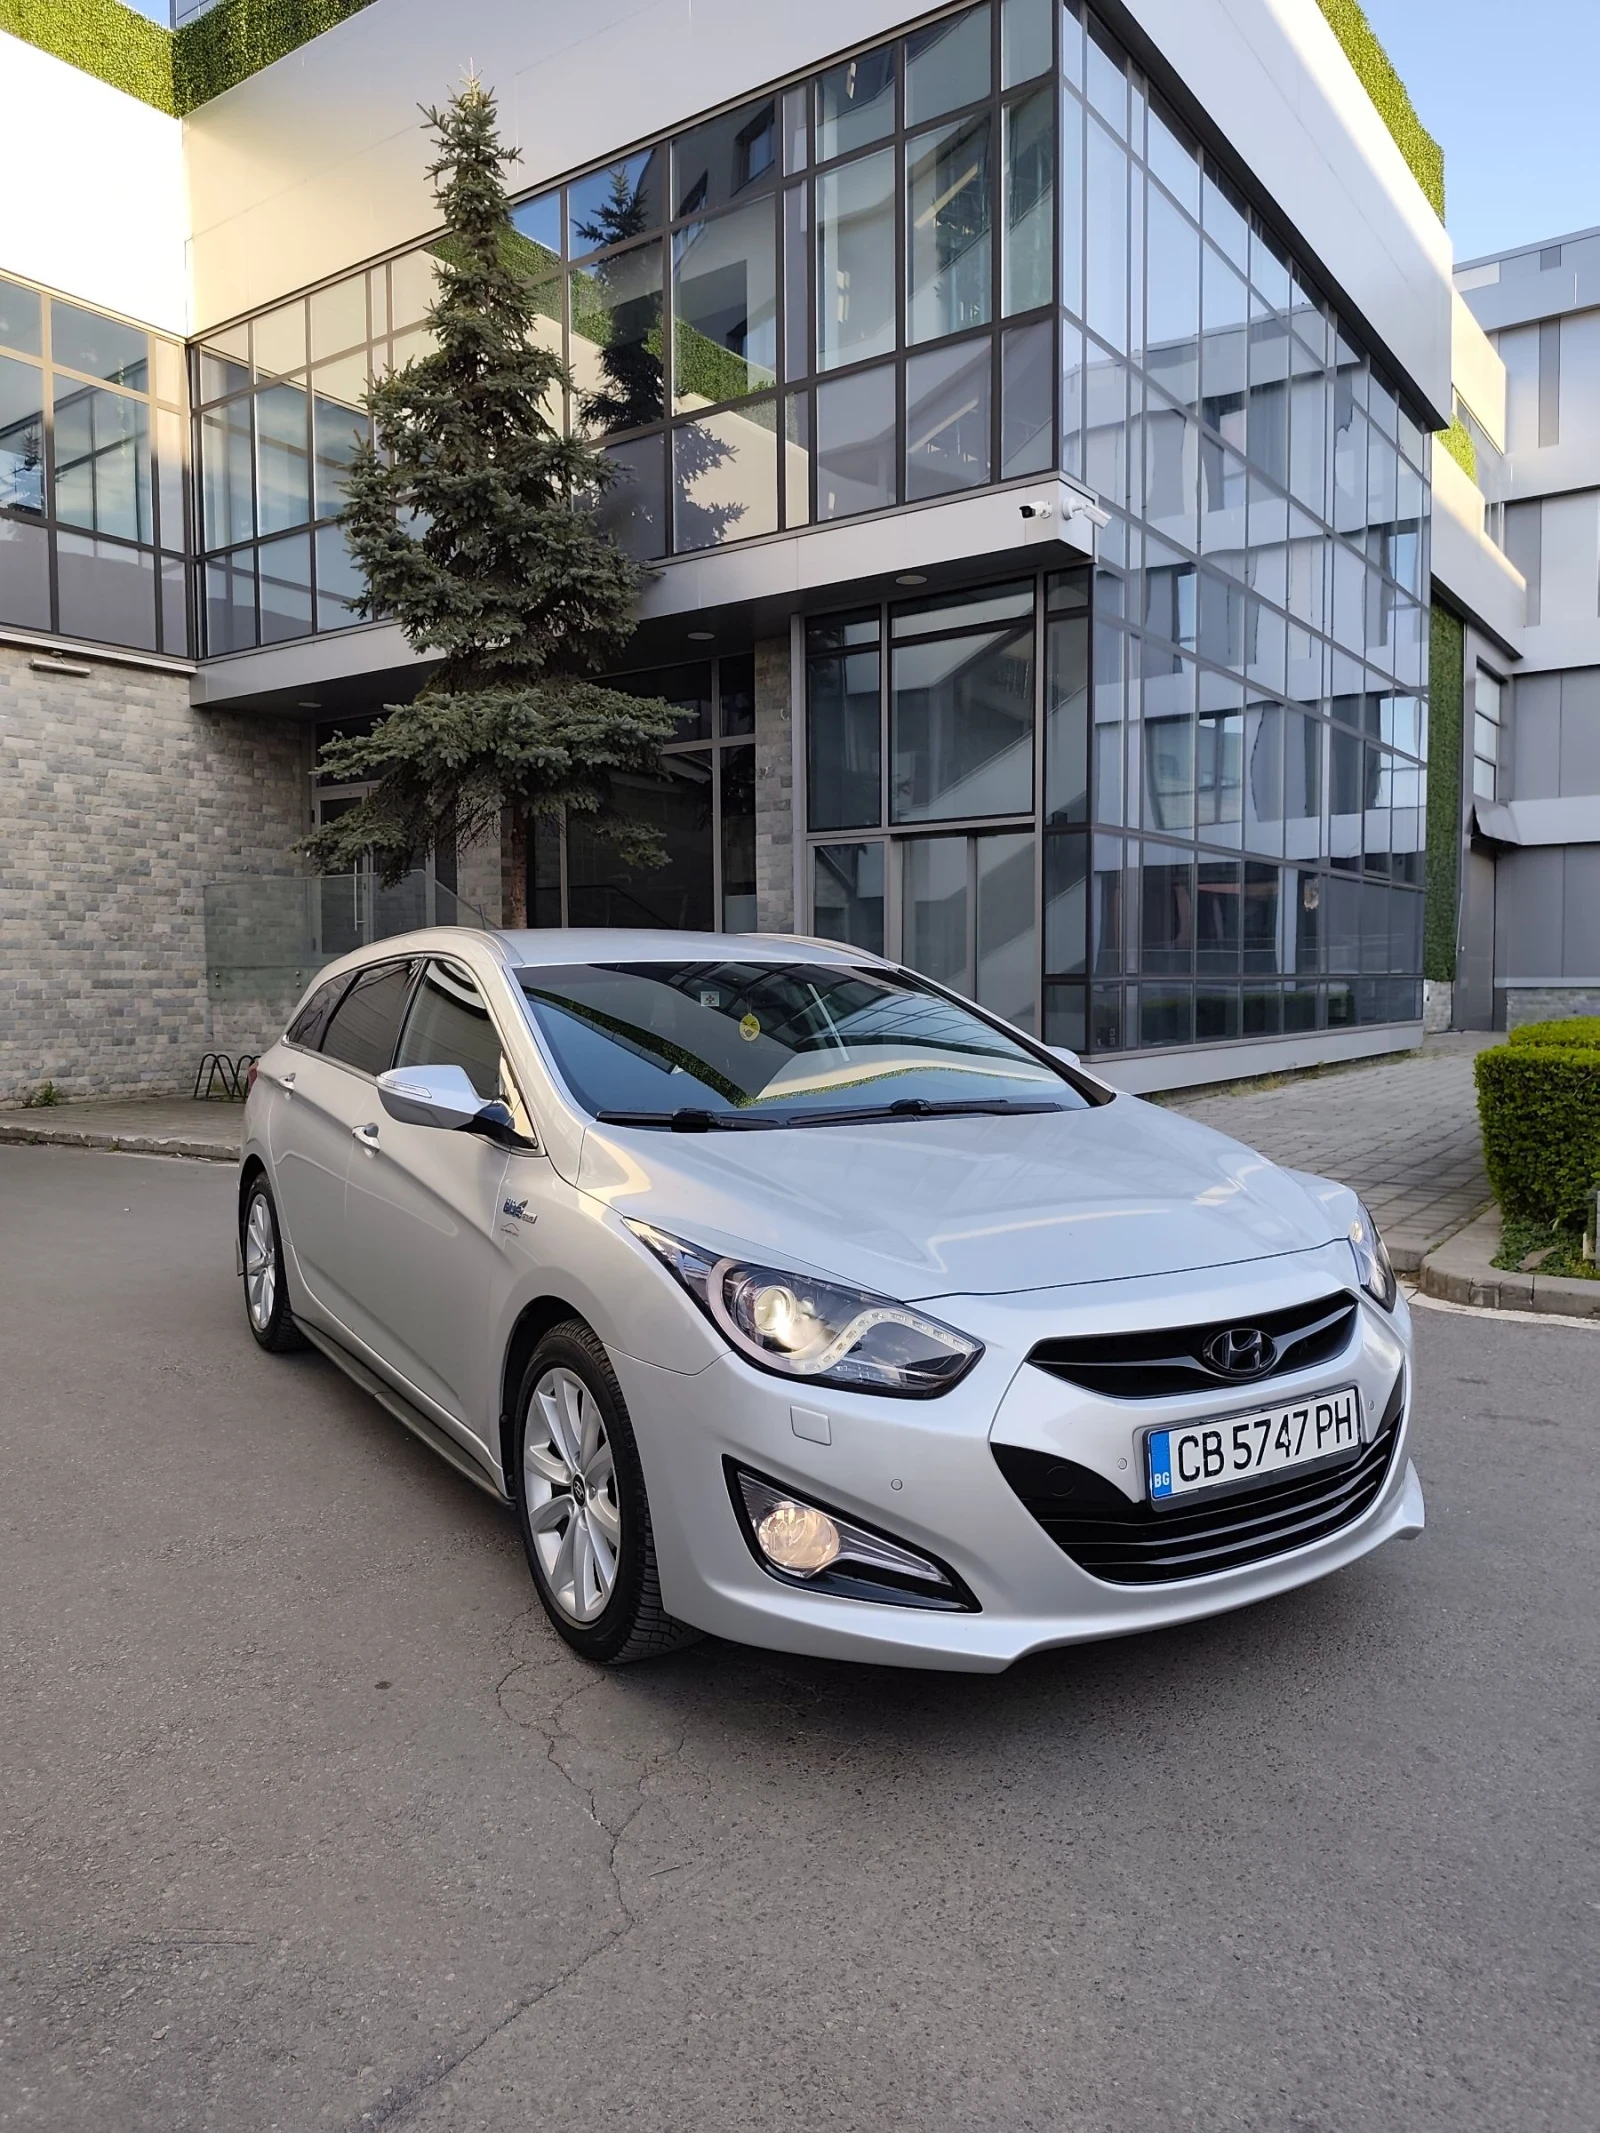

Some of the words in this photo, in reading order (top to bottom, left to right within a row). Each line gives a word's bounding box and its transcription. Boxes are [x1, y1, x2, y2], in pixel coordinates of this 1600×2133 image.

[1178, 1430, 1225, 1482] CB
[1233, 1409, 1309, 1470] 5747
[1316, 1397, 1353, 1449] PH
[1154, 1471, 1170, 1488] BG
